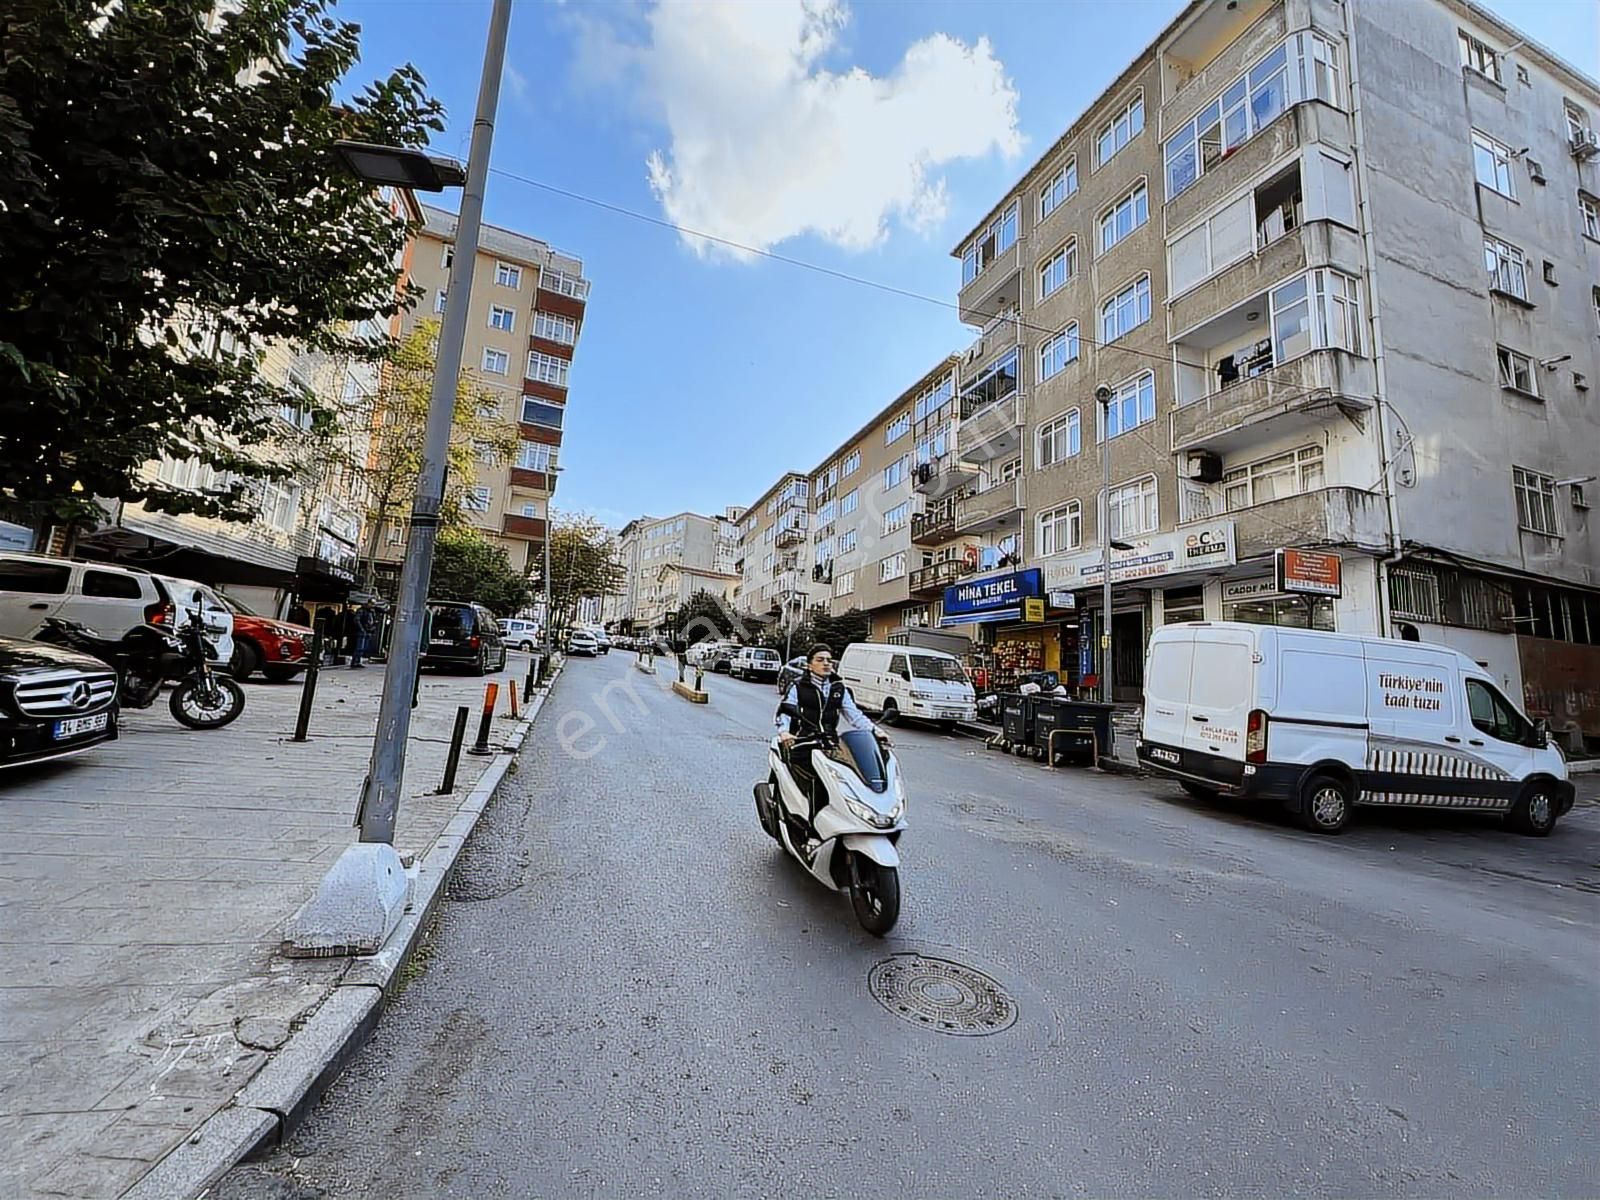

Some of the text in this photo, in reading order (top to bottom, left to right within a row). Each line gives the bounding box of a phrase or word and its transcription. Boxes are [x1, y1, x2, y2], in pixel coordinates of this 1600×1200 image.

[1189, 544, 1225, 557] THERMA
[985, 579, 1017, 597] TEKEL
[1378, 672, 1444, 693] Türkiye'nin
[1384, 693, 1440, 711] tadı tuzu
